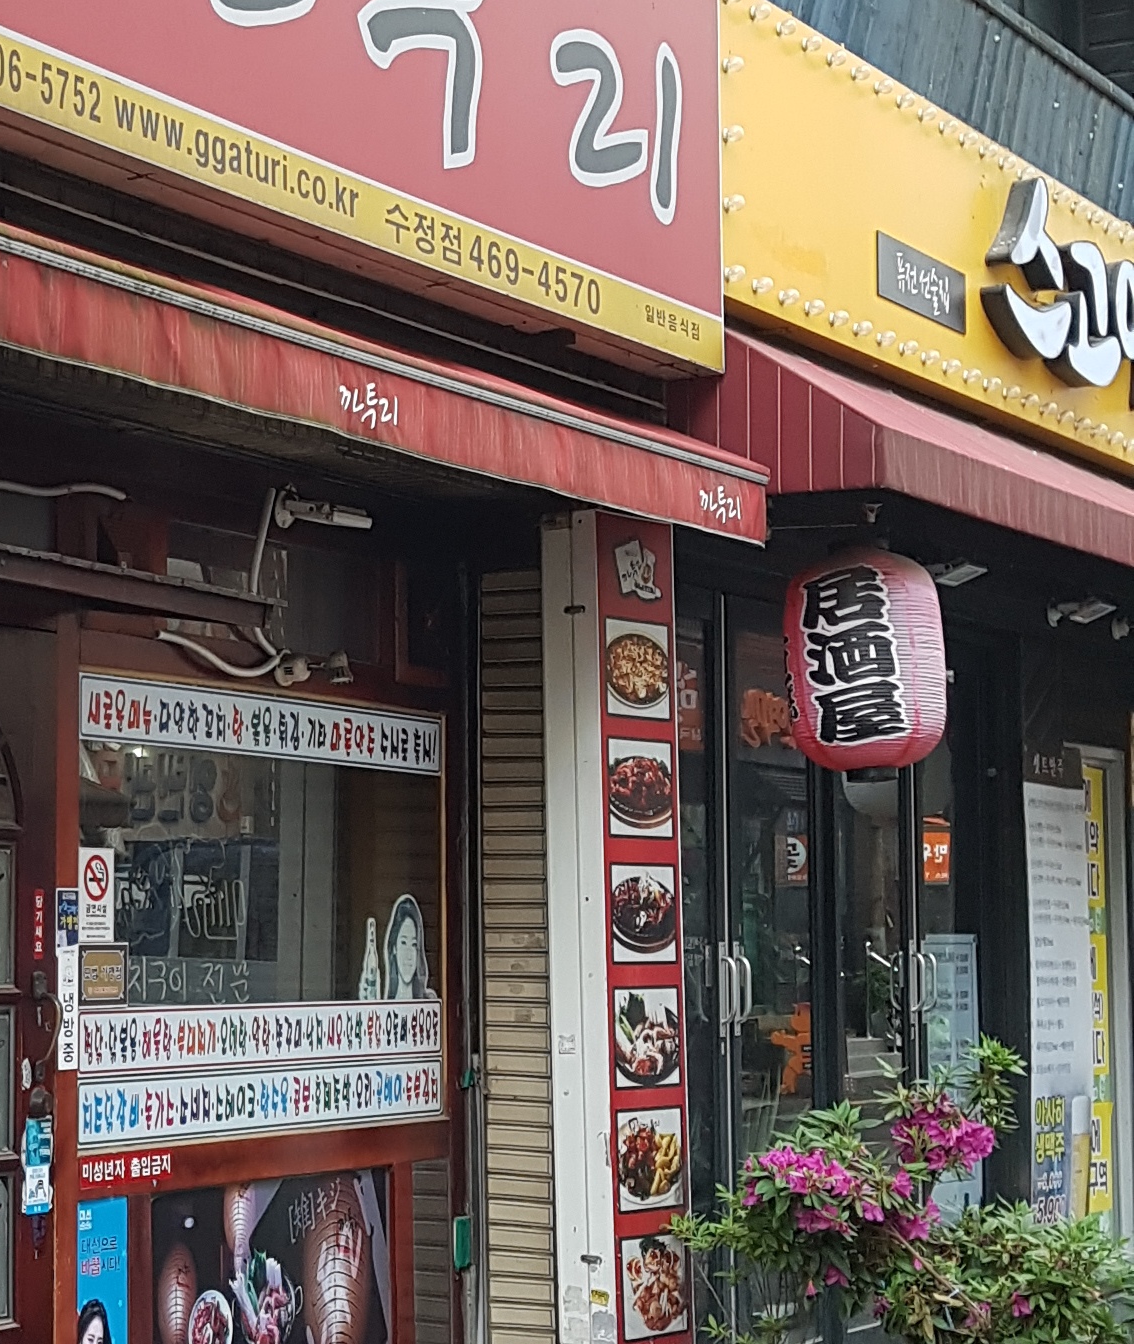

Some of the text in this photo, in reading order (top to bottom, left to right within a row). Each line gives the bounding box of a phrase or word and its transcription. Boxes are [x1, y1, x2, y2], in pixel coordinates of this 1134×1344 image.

[114, 93, 360, 219] www.ggaturi.co.kr
[644, 302, 702, 342] 일반음식점
[82, 1153, 171, 1183] 미성년자 출입금지
